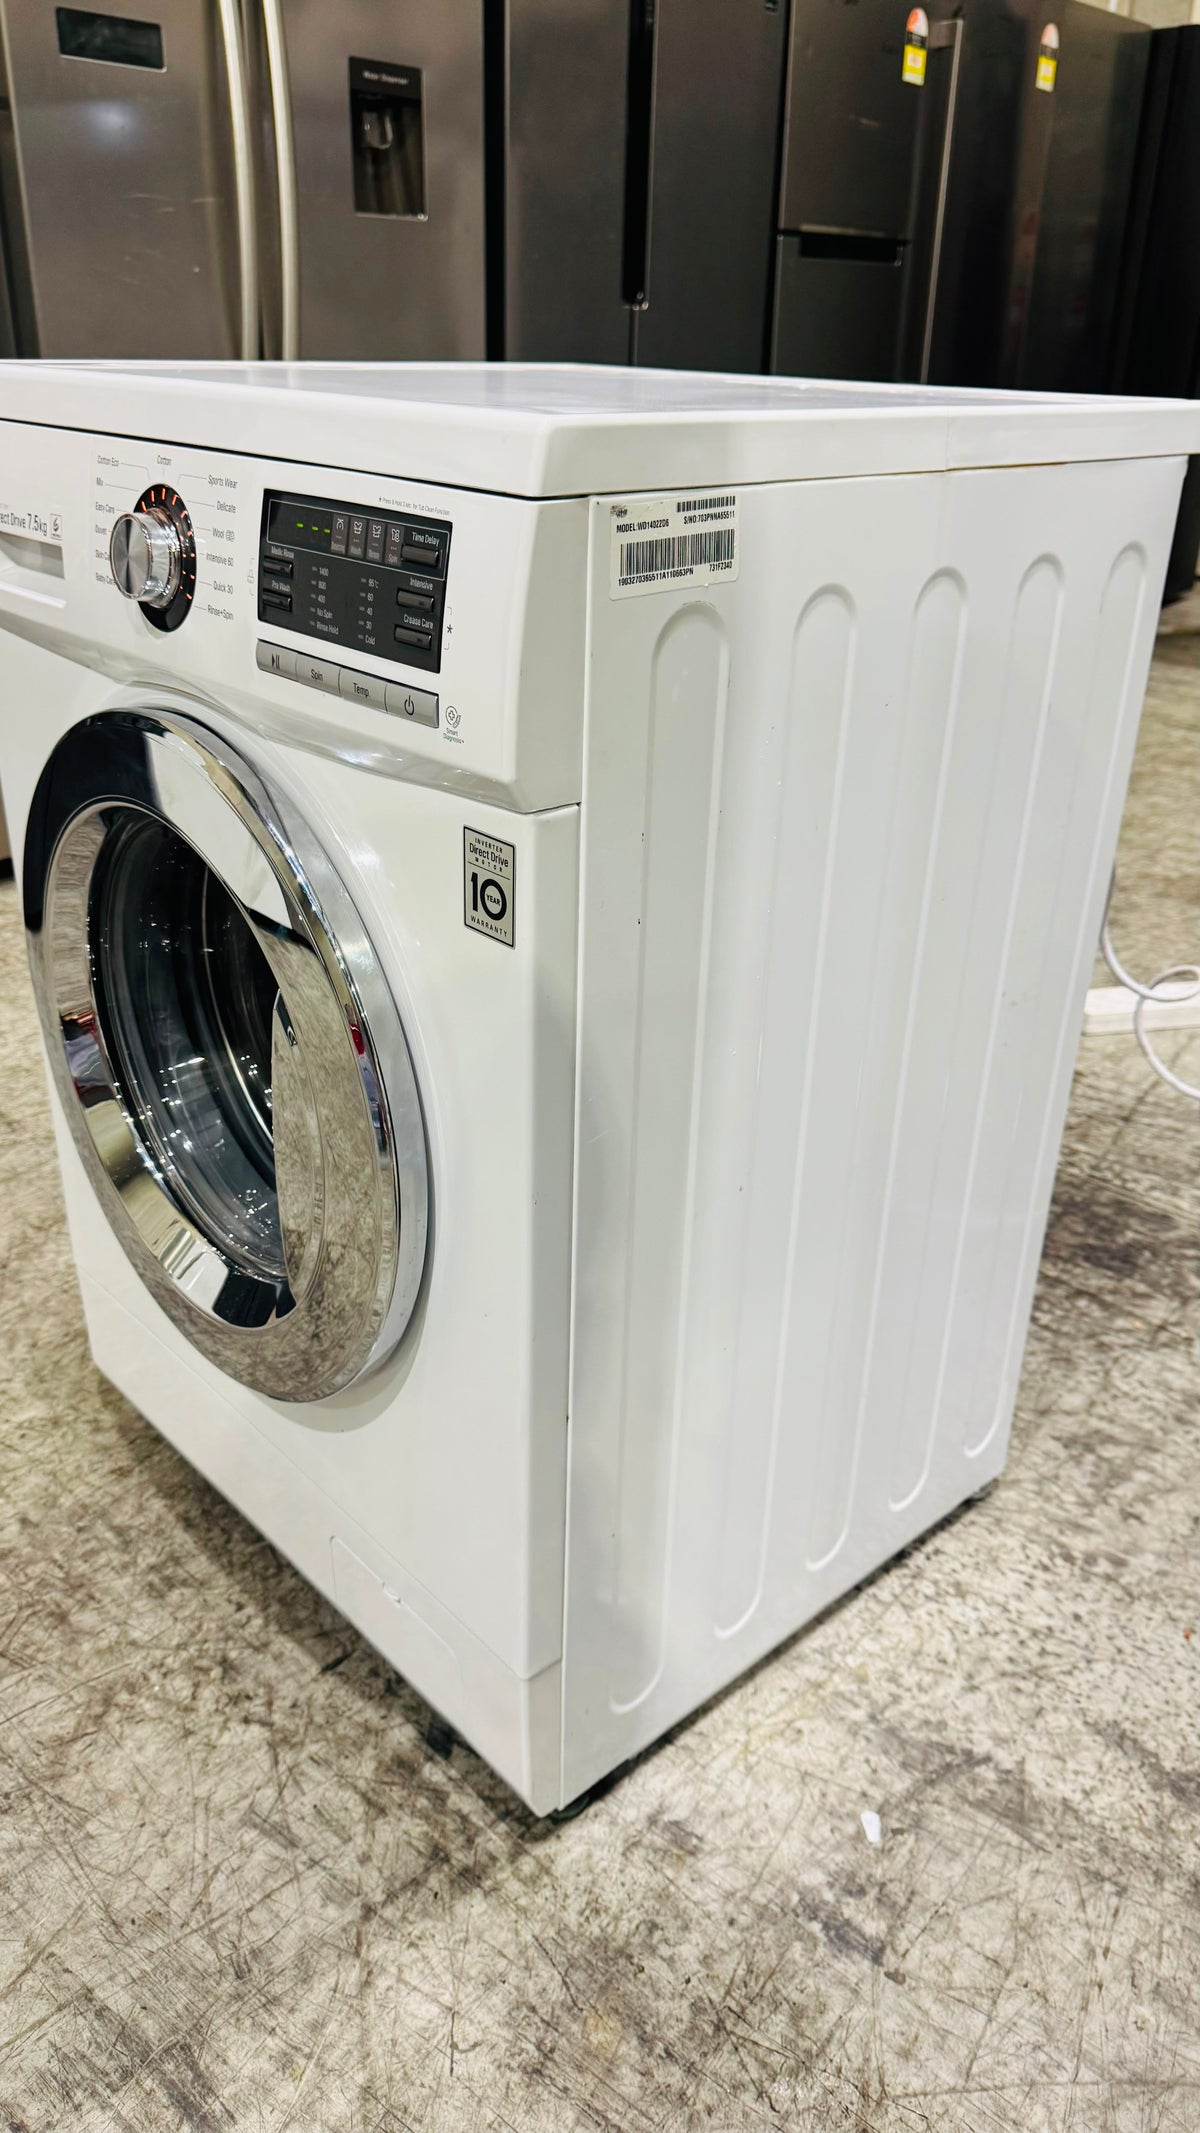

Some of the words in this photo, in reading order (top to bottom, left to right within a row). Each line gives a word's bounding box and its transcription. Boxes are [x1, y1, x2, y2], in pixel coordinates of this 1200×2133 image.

[157, 454, 172, 466] Cotton
[208, 474, 224, 487] Sports
[224, 477, 238, 489] Wear
[95, 501, 105, 513] Easy
[105, 504, 115, 514] Care
[216, 500, 236, 514] Delicate
[11, 512, 26, 529] Drive
[28, 512, 47, 537] 7.5kg
[212, 527, 225, 538] Wool
[412, 531, 425, 543] Time
[424, 534, 440, 547] Delay
[206, 552, 227, 566] Intensive
[227, 556, 234, 567] 60
[213, 580, 226, 593] Quick
[227, 584, 234, 595] 30
[409, 577, 433, 590] Intensive
[367, 592, 374, 602] 60
[316, 608, 323, 617] No
[323, 609, 333, 619] Spin
[366, 607, 373, 616] 40
[316, 621, 328, 632] Rinse
[328, 624, 339, 635] Hold
[365, 621, 373, 630] 30
[403, 614, 421, 626] Crease
[421, 618, 434, 630] Care
[364, 635, 376, 645] Cold
[310, 668, 323, 682] Spin
[353, 682, 370, 698] Temp
[475, 837, 503, 854] INVERTER
[469, 842, 490, 860] Direct
[490, 851, 509, 868] Drive
[470, 871, 508, 921] 10
[486, 893, 501, 906] YEAR
[470, 914, 508, 938] WARRANTY
